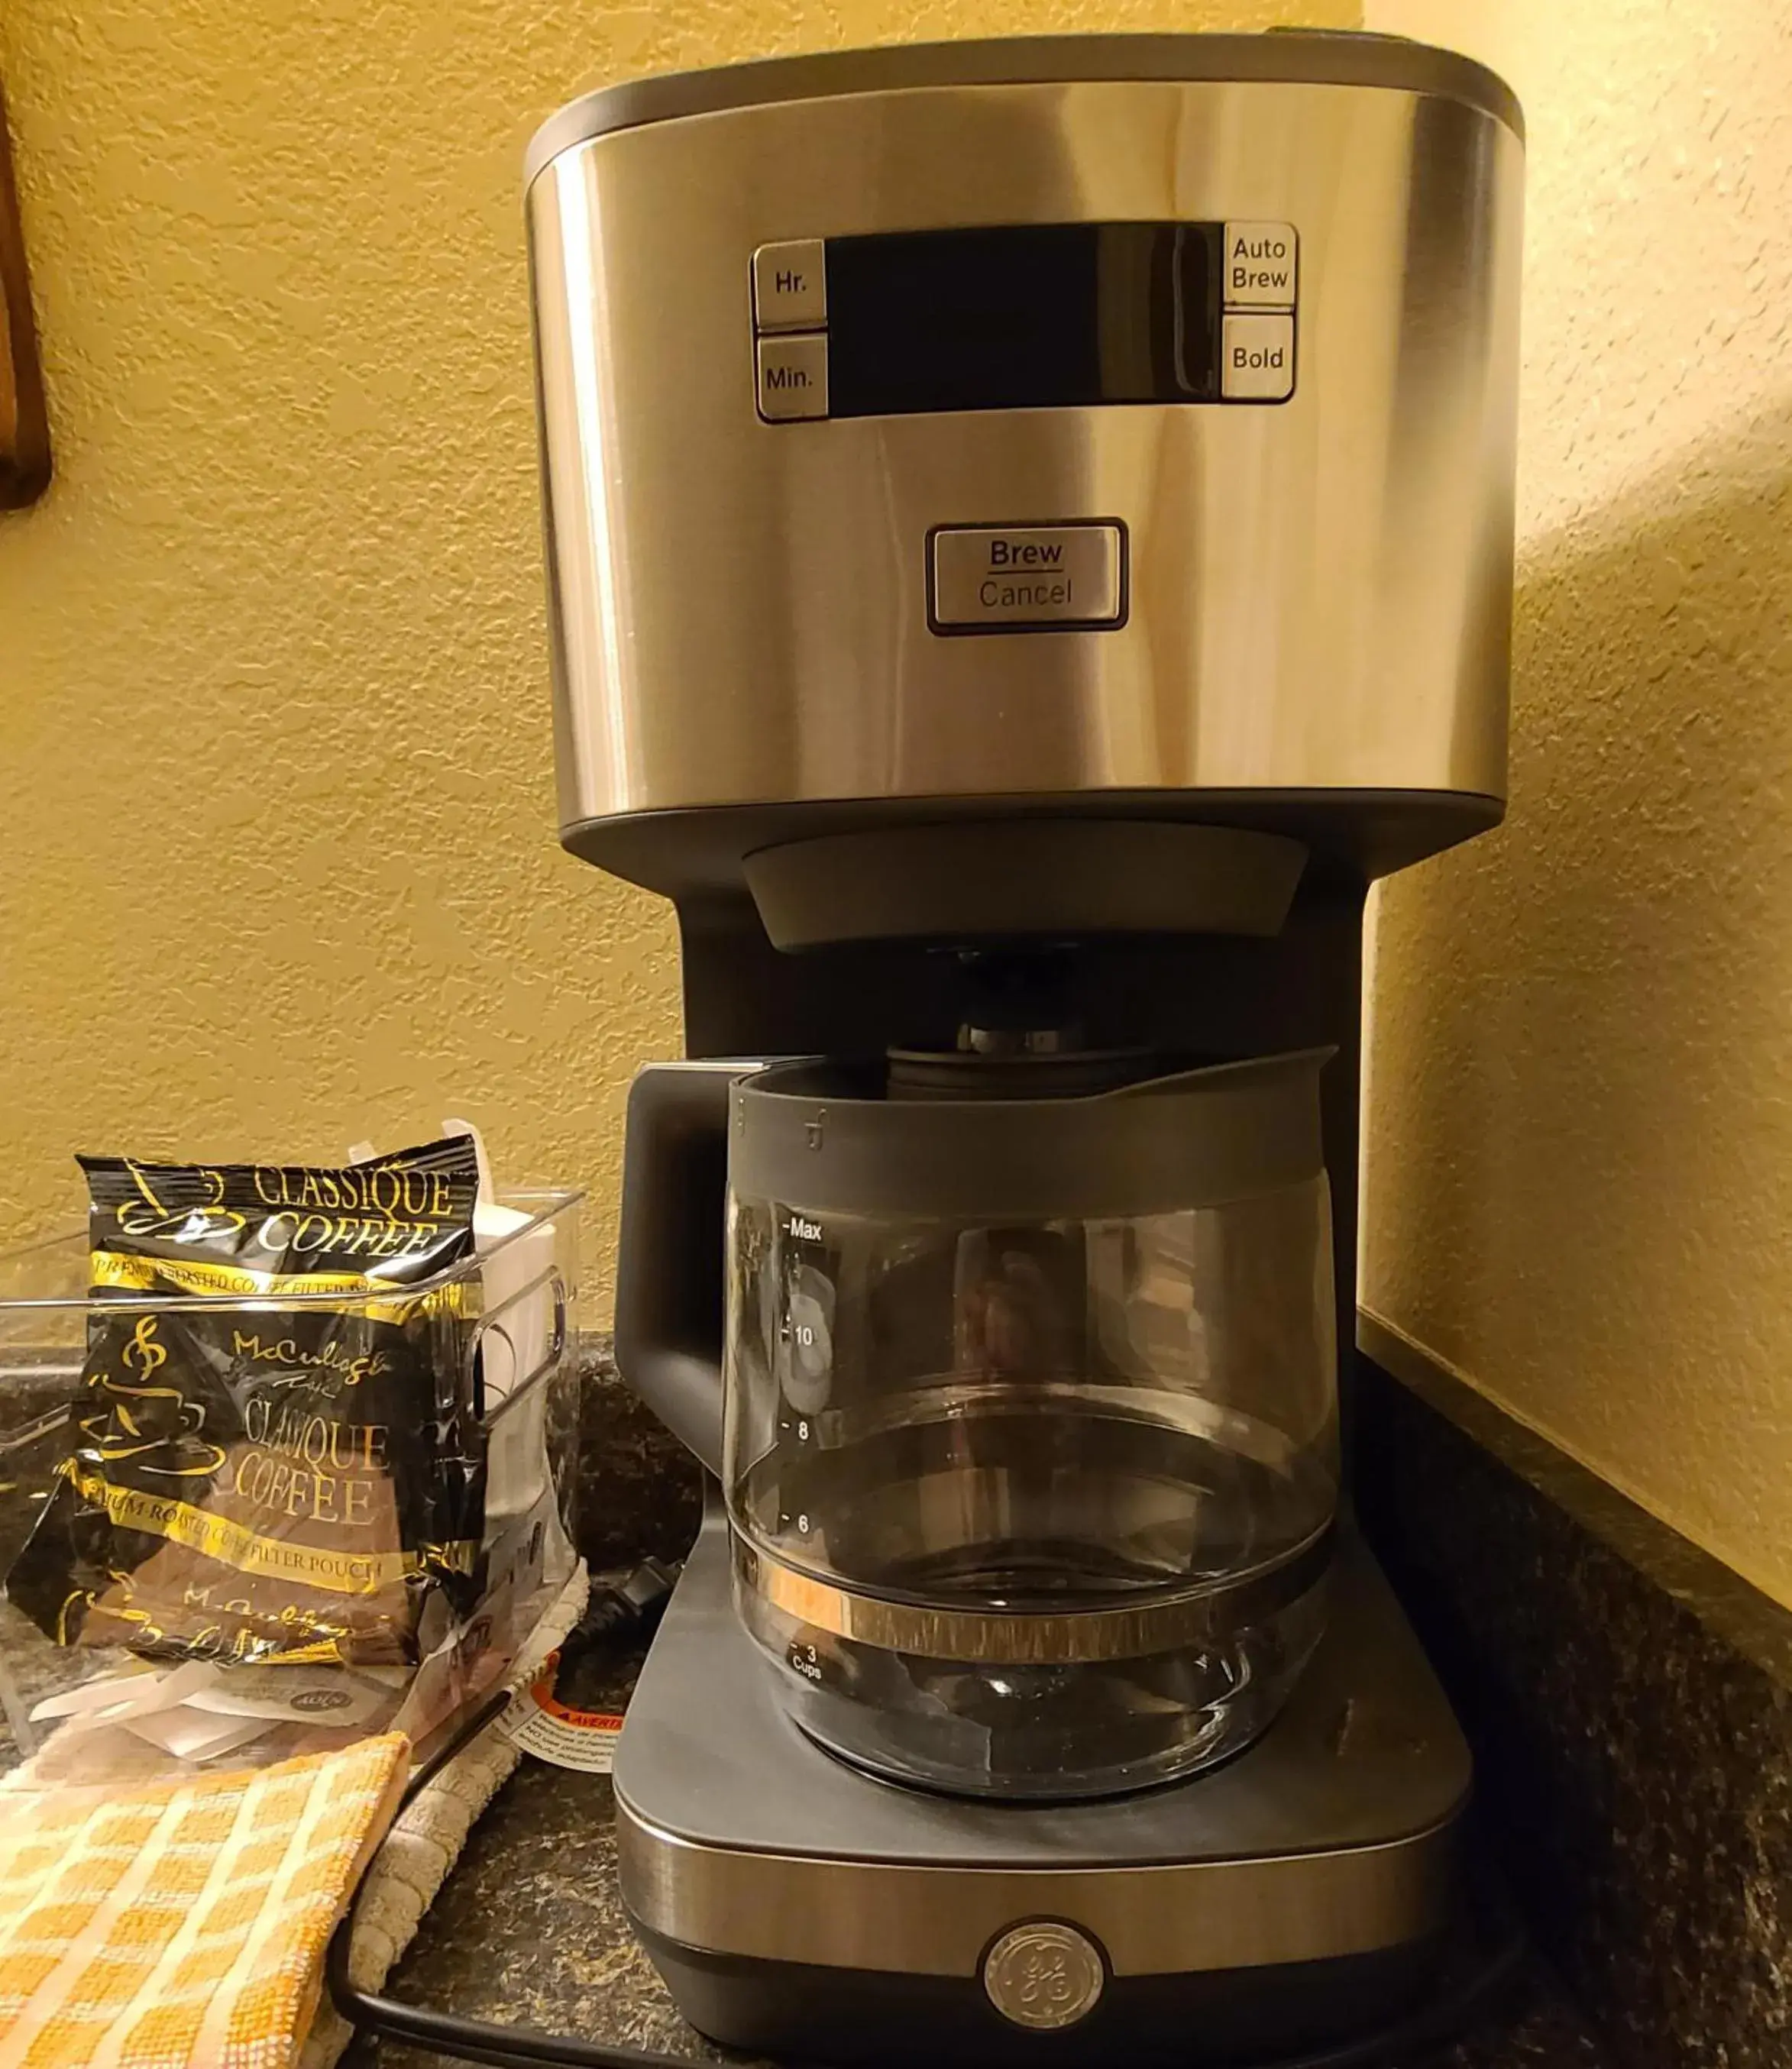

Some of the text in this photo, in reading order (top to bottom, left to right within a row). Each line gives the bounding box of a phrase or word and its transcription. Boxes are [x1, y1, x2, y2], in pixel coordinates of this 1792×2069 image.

[1233, 238, 1286, 260] Auto
[776, 270, 807, 294] Hr.
[1233, 267, 1289, 289] Brew
[1233, 348, 1284, 368] Bold
[766, 367, 813, 390] Min.
[991, 540, 1063, 565] Brew
[979, 579, 1072, 607] Cancel
[254, 1165, 453, 1224] CLASSIQUE
[257, 1212, 439, 1257] COFFEE
[791, 1217, 822, 1240] Max
[794, 1325, 813, 1346] 10
[798, 1421, 809, 1440] 8
[236, 1452, 374, 1526] COFFEE
[798, 1515, 809, 1534] 6
[807, 1645, 817, 1663] 3
[793, 1655, 822, 1679] Cups
